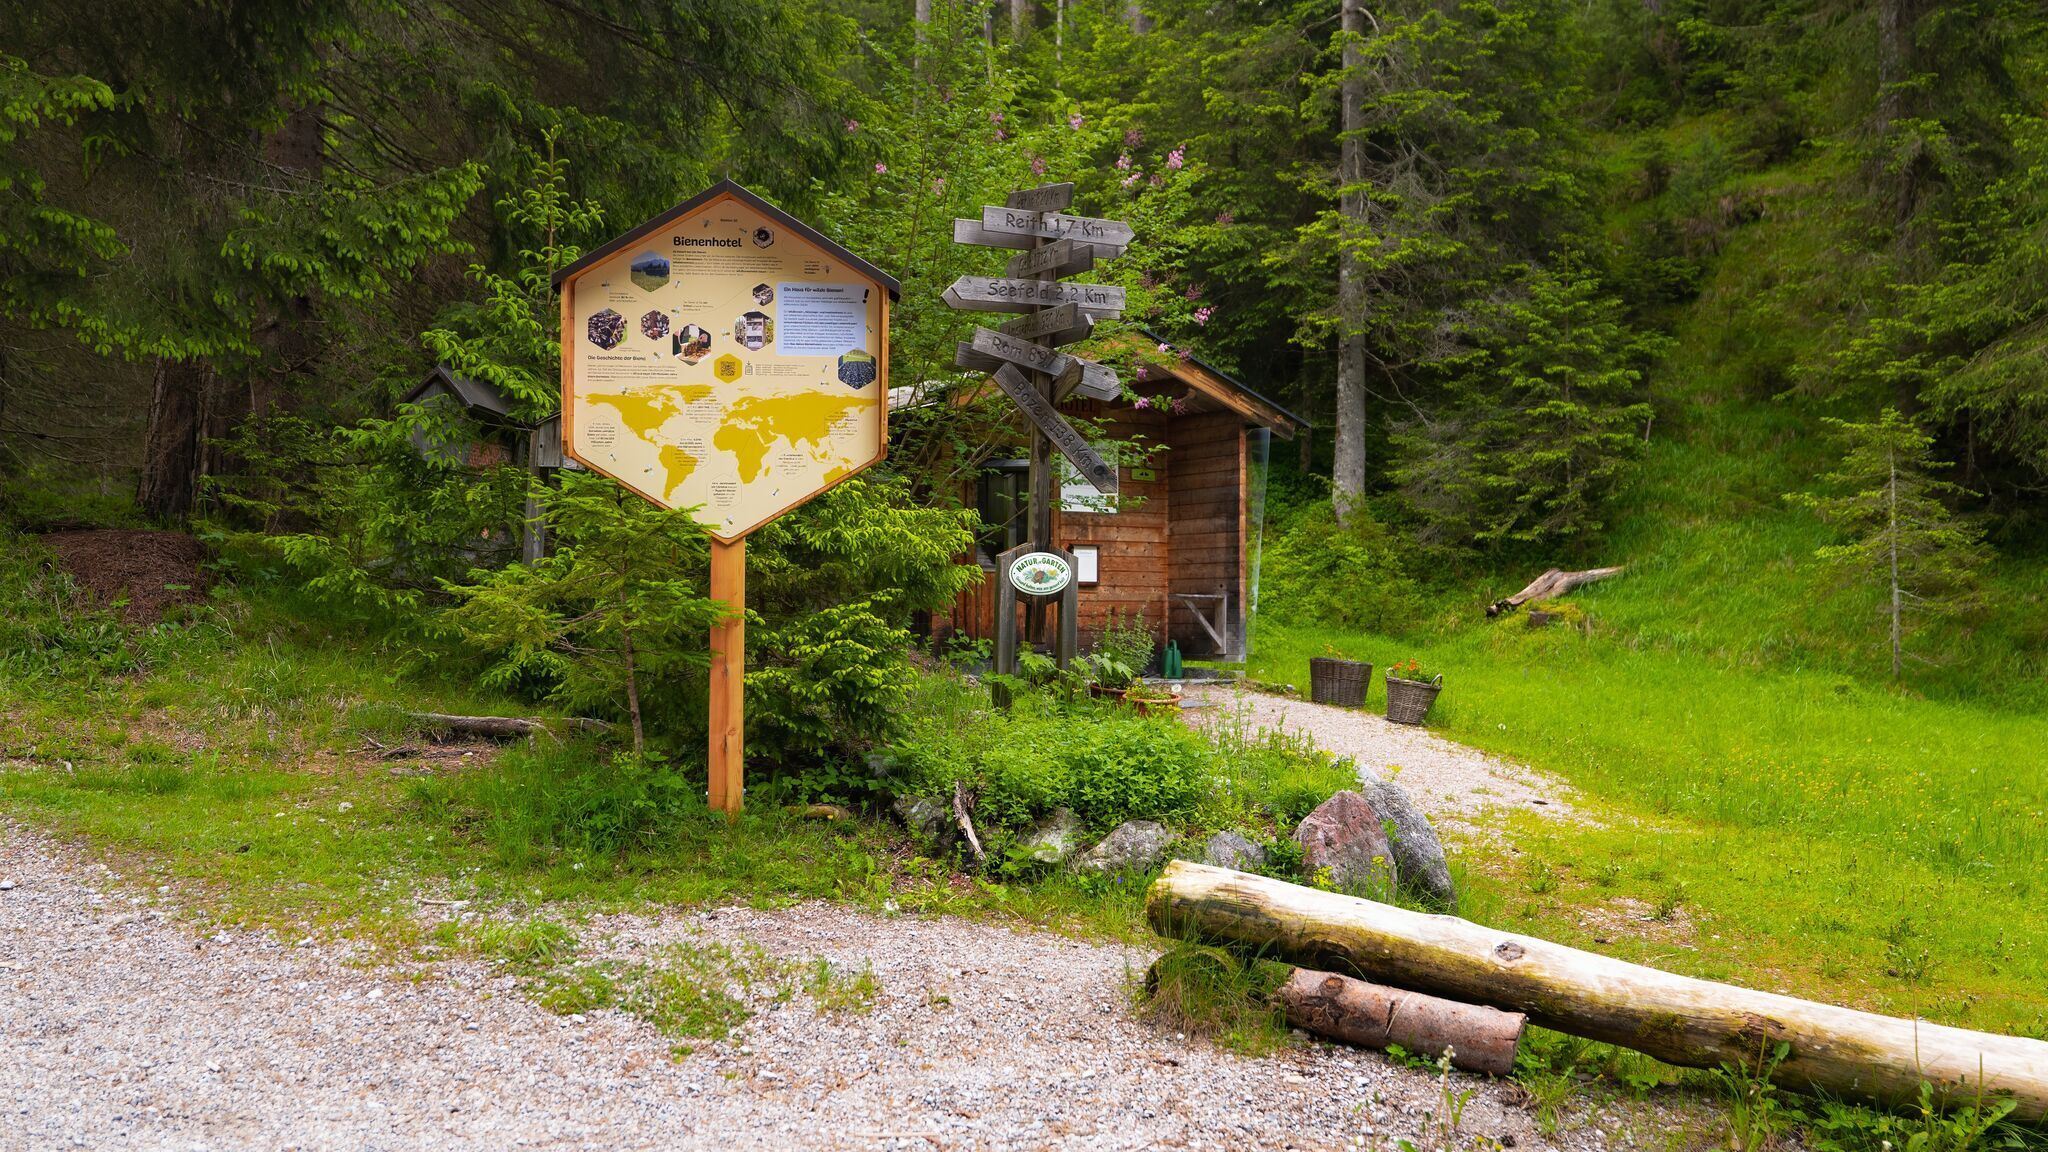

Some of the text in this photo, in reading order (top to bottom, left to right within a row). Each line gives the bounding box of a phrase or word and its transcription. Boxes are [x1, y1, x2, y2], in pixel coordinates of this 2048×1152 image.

[1006, 212, 1048, 231] Reith
[1082, 219, 1104, 238] Km
[673, 236, 742, 247] Bienenhotel
[987, 281, 1049, 300] Seefeld
[1085, 287, 1107, 305] Km
[992, 335, 1022, 357] Rom
[1013, 382, 1050, 425] Bozen
[1049, 420, 1075, 447] 138
[1072, 443, 1093, 467] Km
[1016, 557, 1037, 572] NATUR
[1042, 557, 1066, 573] GARTEN
